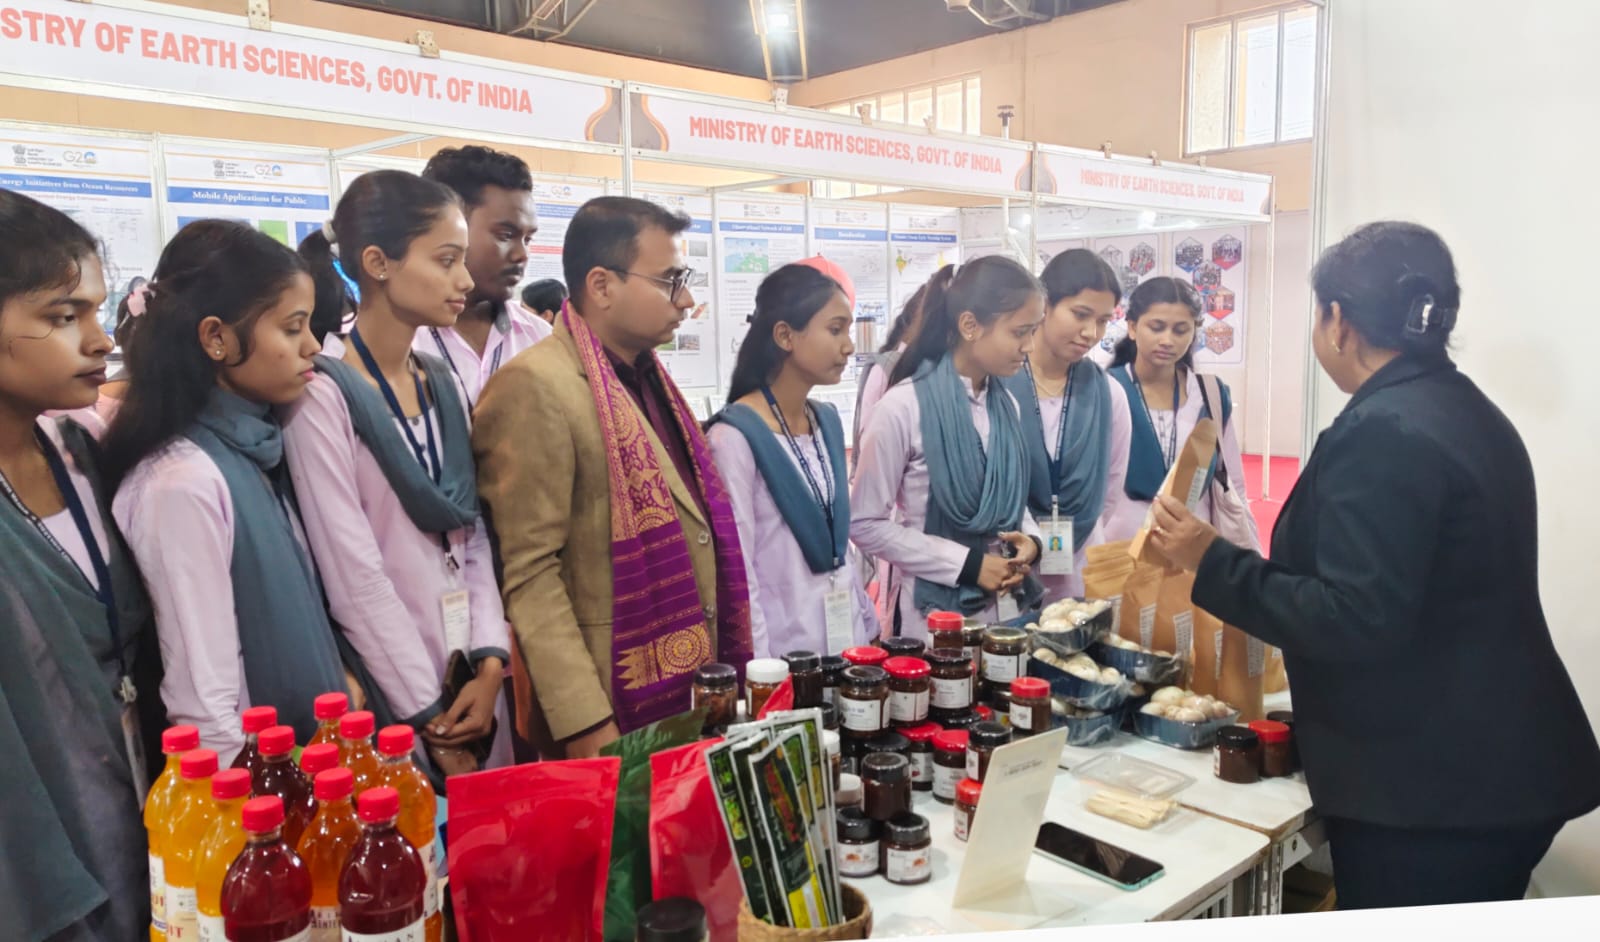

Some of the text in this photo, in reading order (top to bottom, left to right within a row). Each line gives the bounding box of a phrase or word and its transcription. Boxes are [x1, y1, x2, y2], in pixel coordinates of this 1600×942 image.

[94, 21, 134, 54] OF
[140, 28, 237, 70] EARTH
[242, 44, 372, 93] SCIENCES,
[377, 65, 442, 100] GOVT.
[446, 76, 474, 104] OF
[478, 82, 533, 114] INDIA
[689, 116, 1002, 174] MINISTRY OF EARTH SCIENCES, GOVT. OF INDIA
[192, 190, 307, 205] Mobile Applications for Public
[1080, 168, 1118, 188] MINISTRY
[1132, 176, 1159, 192] EARTH
